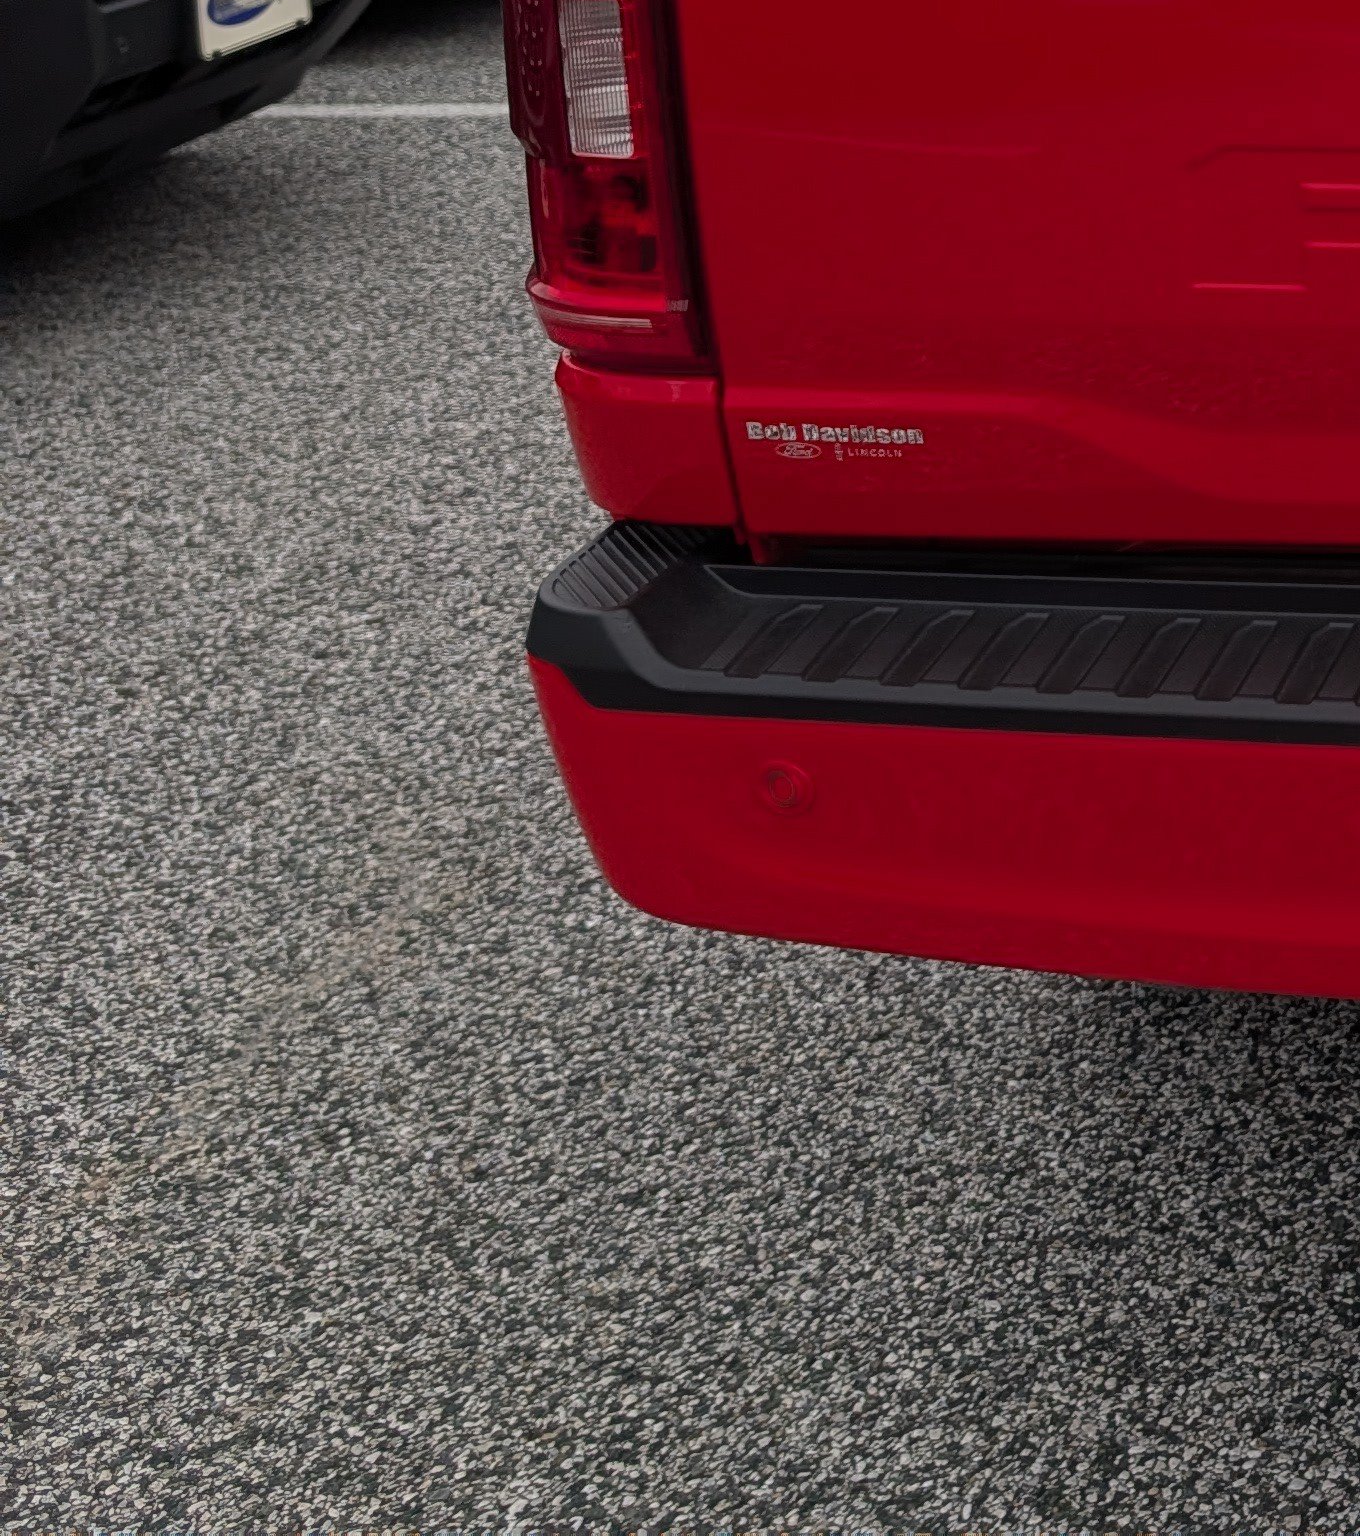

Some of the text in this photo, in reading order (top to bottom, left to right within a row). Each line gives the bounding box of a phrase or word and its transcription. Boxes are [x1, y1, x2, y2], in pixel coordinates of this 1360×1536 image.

[746, 421, 924, 444] Bob Davidson
[847, 447, 903, 458] LINCOLN
